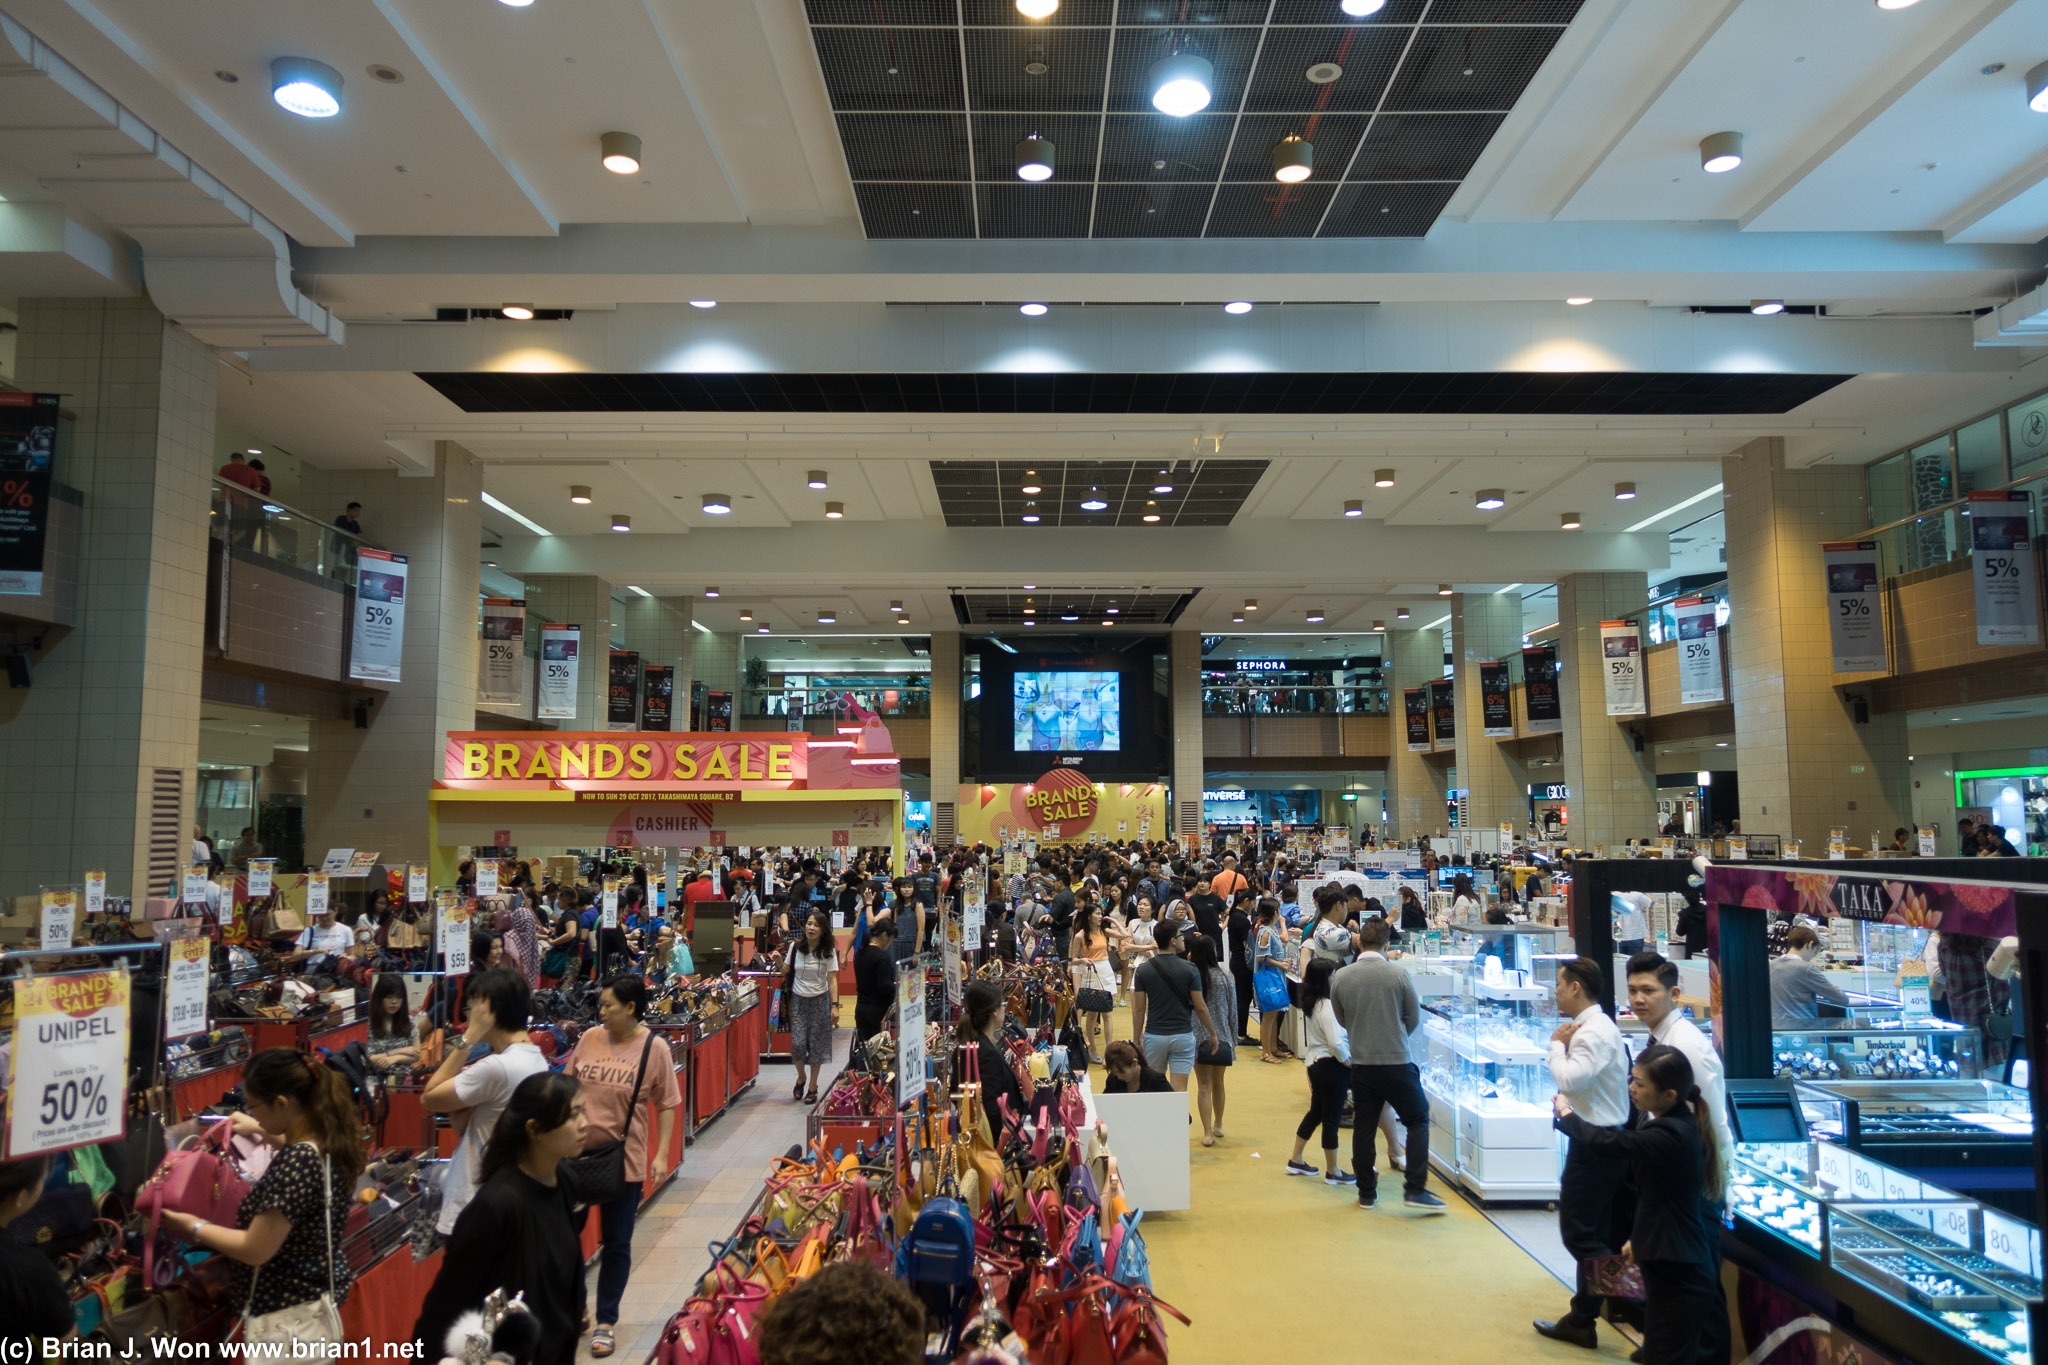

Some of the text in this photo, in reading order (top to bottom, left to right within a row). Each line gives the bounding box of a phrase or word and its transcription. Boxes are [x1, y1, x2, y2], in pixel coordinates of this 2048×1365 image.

[1986, 557, 2020, 578] 5%
[1840, 598, 1870, 616] 5%
[365, 605, 393, 626] 5%
[489, 645, 513, 659] 5%
[1687, 643, 1710, 659] 5%
[548, 665, 569, 678] 5%
[1236, 661, 1286, 670] SEPHORA
[1612, 661, 1634, 675] 5%
[610, 685, 631, 697] 6%
[1531, 682, 1553, 695] 6%
[647, 698, 667, 709] 6%
[1486, 694, 1506, 706] 6%
[711, 717, 727, 728] 6%
[1410, 715, 1425, 725] 6%
[463, 743, 794, 780] BRANDS SALE
[583, 792, 734, 801] NOW TO SUN 29 OCT 2017, TAKASHIMAYA SQUARE, B2
[1026, 784, 1101, 808] BRANDS
[1043, 801, 1090, 822] SALE
[636, 817, 698, 831] CASHIER
[622, 834, 628, 843] 2
[716, 834, 721, 843] 3
[837, 833, 844, 843] 4
[1921, 844, 1934, 853] 70%
[90, 896, 102, 906] 50%
[311, 898, 325, 909] 30%
[1837, 883, 1884, 912] TAKA
[50, 907, 70, 915] KIPLING
[1840, 908, 1884, 919] JEWELLERY
[48, 925, 68, 939] 50%
[968, 927, 979, 942] 50%
[451, 952, 466, 968] $59
[48, 976, 118, 1000] BRANDS
[61, 992, 105, 1013] SALE
[39, 1017, 116, 1044] UNIPEL
[1865, 1039, 1906, 1049] Timberland
[905, 1046, 921, 1081] 50%
[40, 1074, 107, 1125] 50%
